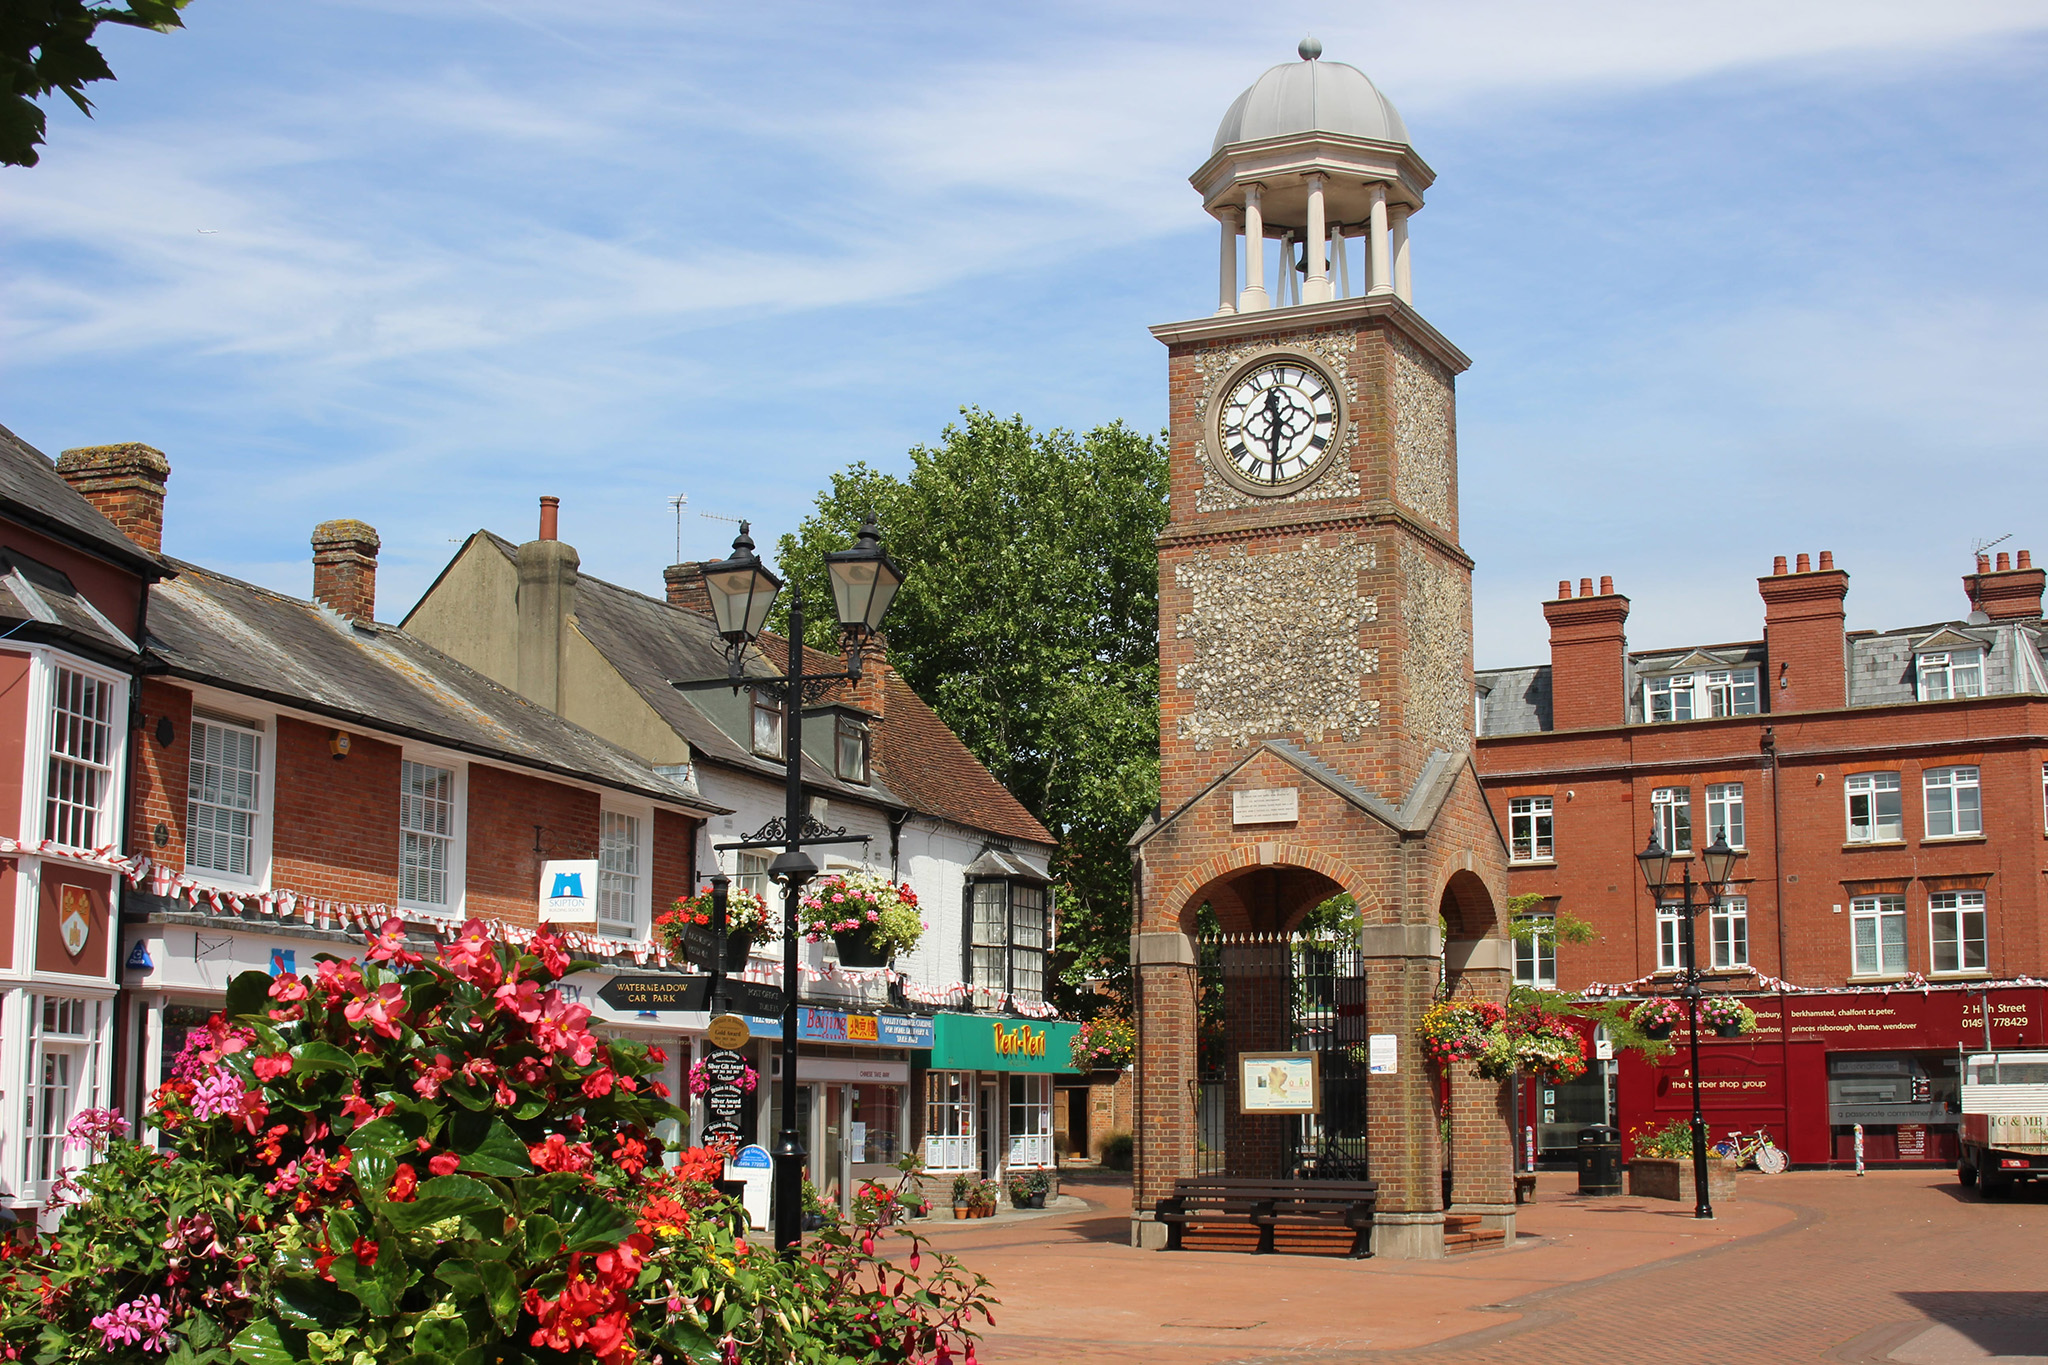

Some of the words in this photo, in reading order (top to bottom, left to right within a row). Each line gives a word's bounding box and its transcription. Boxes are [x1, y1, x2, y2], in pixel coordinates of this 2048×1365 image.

[549, 899, 585, 907] SKIPTON
[616, 983, 688, 992] WATERMEADOW
[628, 994, 647, 1003] CAR
[653, 994, 676, 1003] PARK
[1963, 1005, 1969, 1014] 2
[1972, 1004, 1994, 1014] Hh
[1998, 1004, 2026, 1013] Street
[806, 1009, 847, 1036] Beijing
[1791, 1025, 1815, 1033] princes
[1817, 1024, 1855, 1032] risborough,
[1857, 1023, 1881, 1031] thame,
[1883, 1022, 1917, 1030] wendover
[1962, 1019, 1983, 1028] 0149
[1993, 1017, 2028, 1027] 778429
[993, 1022, 1045, 1056] Peri-Peri
[1719, 1081, 1739, 1089] shop
[1742, 1081, 1766, 1089] group
[1845, 1110, 1885, 1118] passionate
[1997, 1116, 2006, 1126] G
[2010, 1116, 2020, 1126] &
[2023, 1116, 2043, 1126] MB
